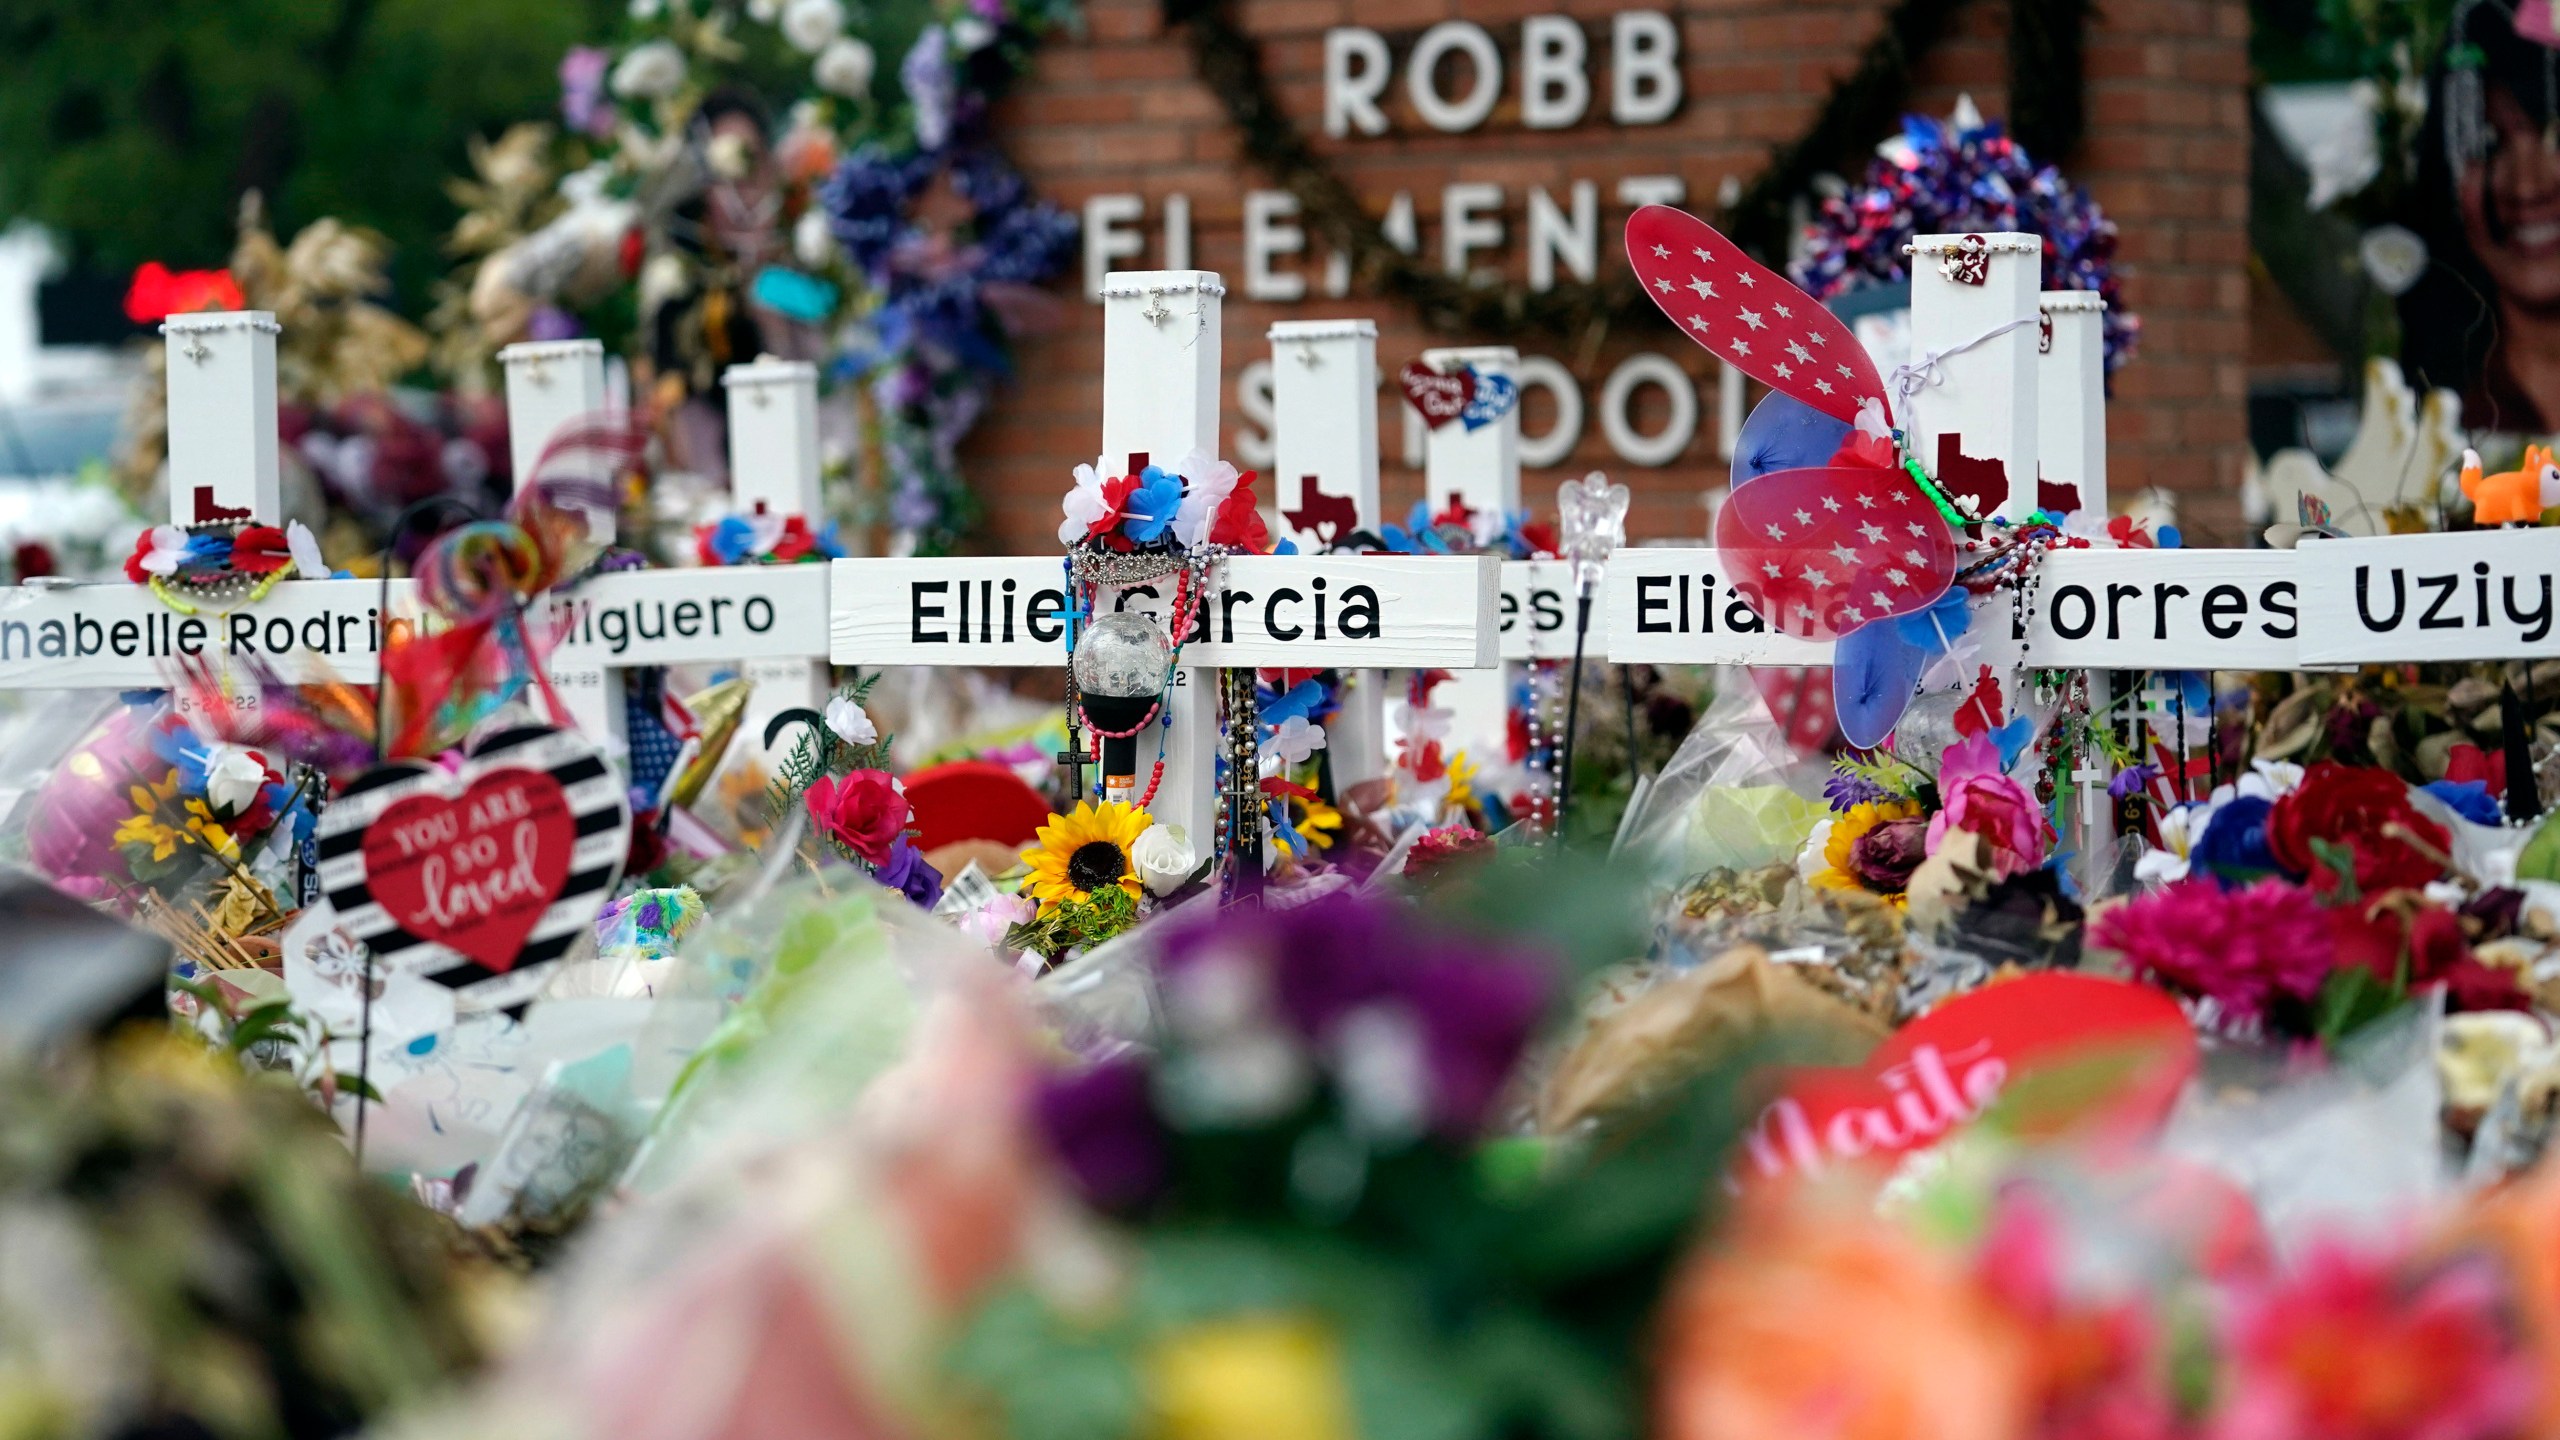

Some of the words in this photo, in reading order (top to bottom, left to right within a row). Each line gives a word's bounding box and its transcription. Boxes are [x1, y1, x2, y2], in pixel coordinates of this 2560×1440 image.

[1324, 11, 1683, 137] ROBB
[1235, 353, 1746, 469] SOOL
[230, 608, 428, 657] Rodri
[550, 595, 775, 653] ilguero
[911, 579, 1067, 643] Ellie
[1114, 576, 1380, 643] Garcia
[2001, 576, 2298, 641] Torres
[392, 808, 459, 856] YOU
[468, 785, 532, 833] ARE
[410, 817, 547, 927] loved
[450, 835, 498, 875] SO
